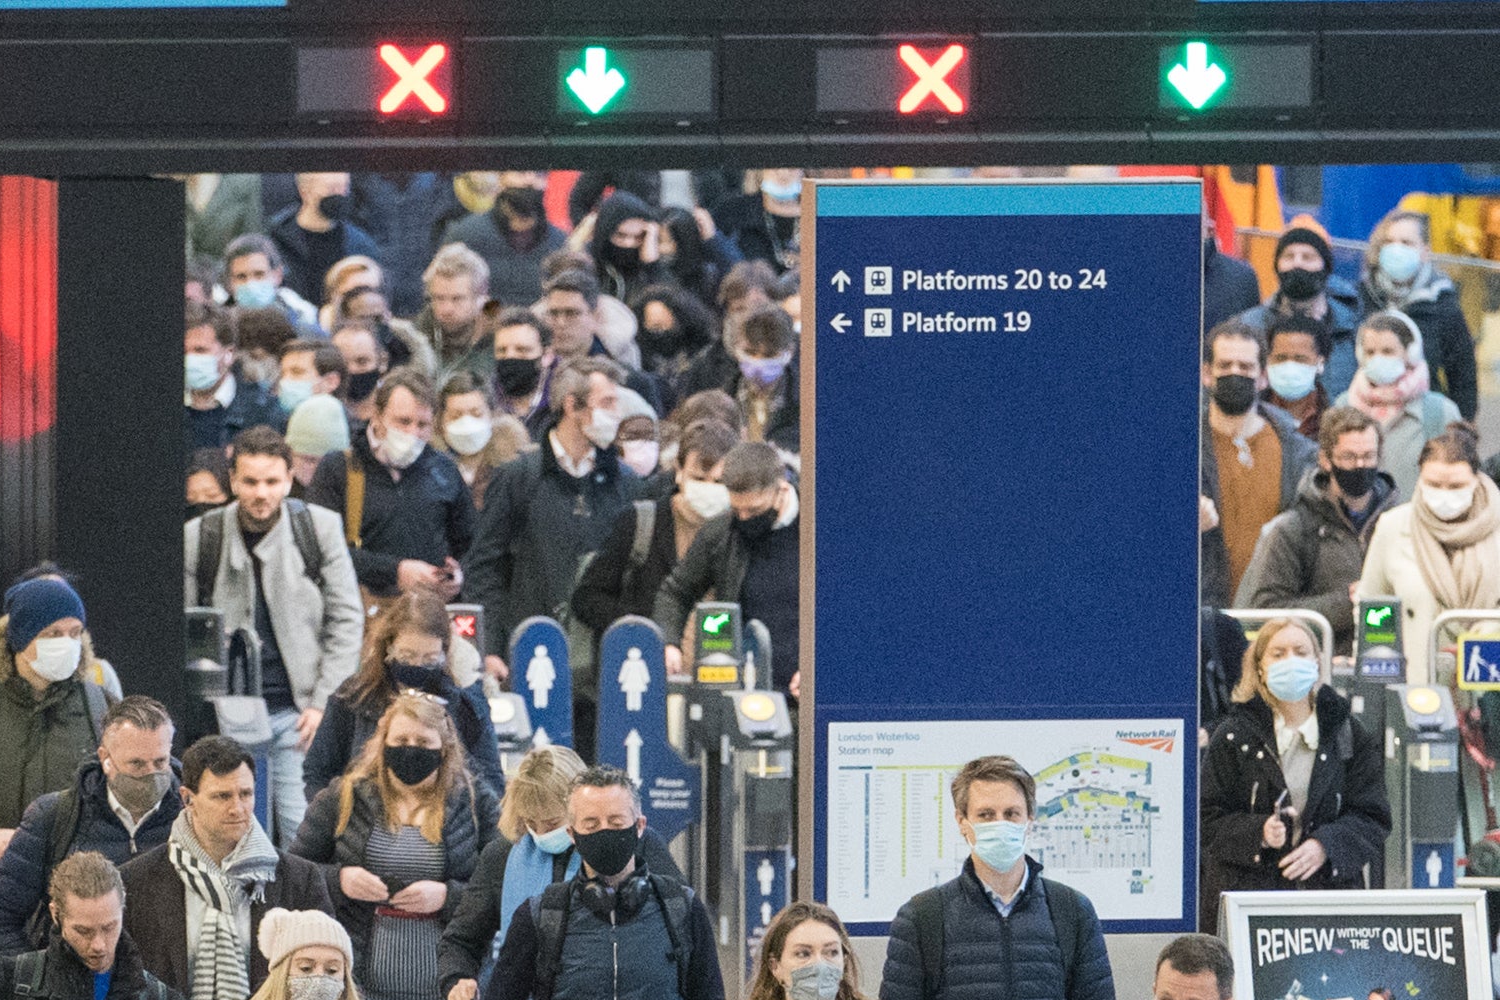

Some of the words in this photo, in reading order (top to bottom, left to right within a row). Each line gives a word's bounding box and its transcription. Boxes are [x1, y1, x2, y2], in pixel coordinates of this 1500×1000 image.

[902, 269, 1008, 291] Platforms
[1014, 269, 1043, 290] 20
[1048, 269, 1072, 290] to
[1078, 268, 1107, 290] 24
[902, 311, 997, 333] Platform
[1003, 311, 1032, 332] 19
[837, 732, 874, 742] London
[876, 731, 921, 742] Waterloo
[837, 745, 870, 756] Station
[873, 747, 895, 756] map
[1336, 927, 1381, 938] WITHOUT
[1256, 927, 1335, 967] RENEW
[1350, 938, 1371, 950] THE
[1382, 926, 1456, 966] QUEUE
